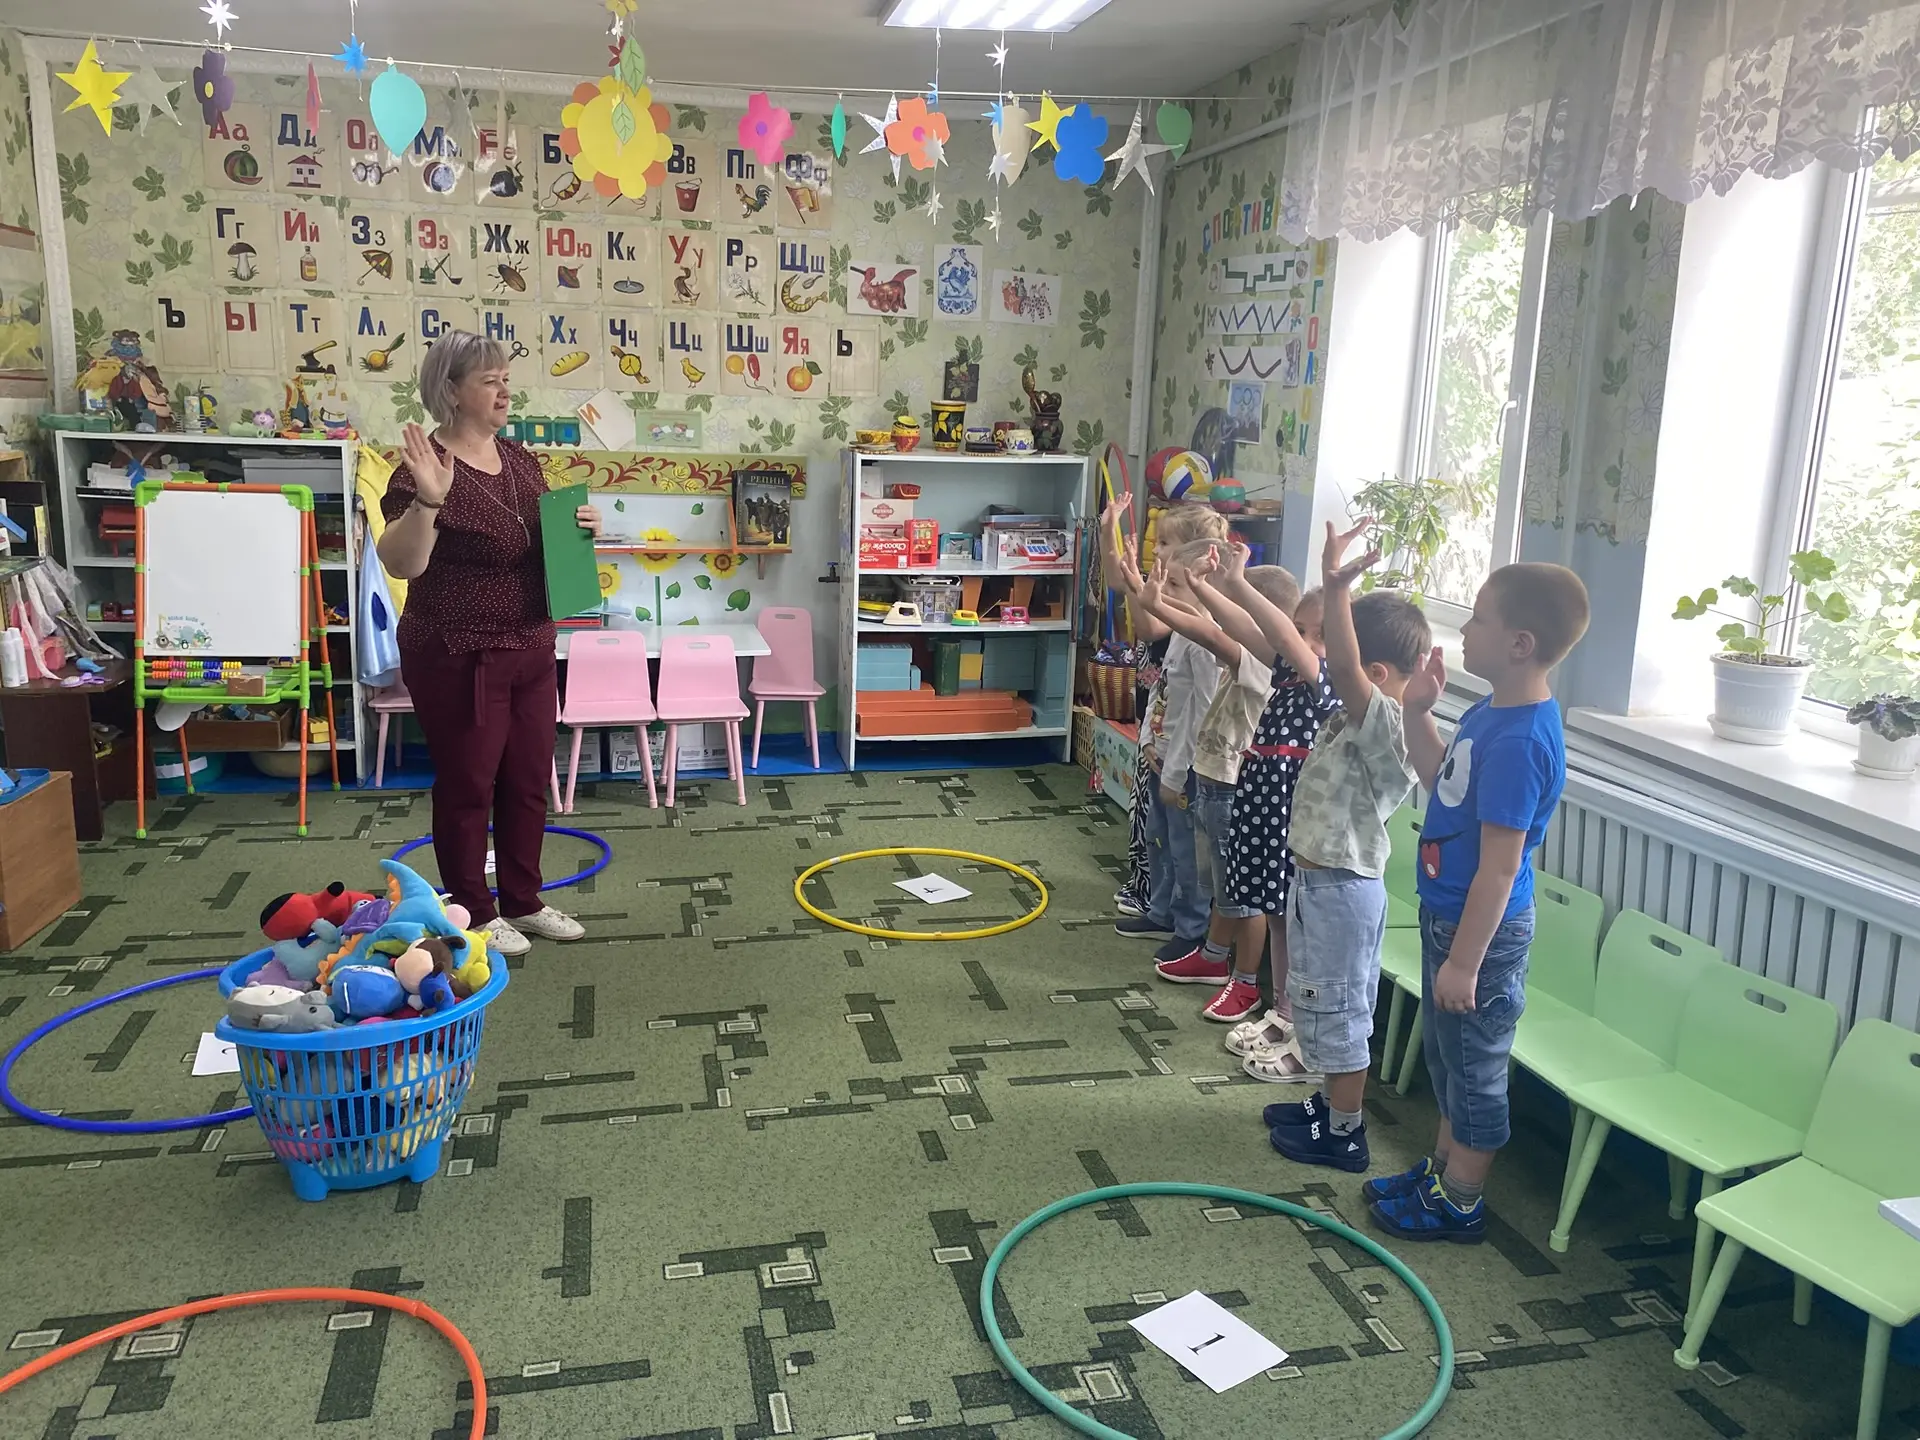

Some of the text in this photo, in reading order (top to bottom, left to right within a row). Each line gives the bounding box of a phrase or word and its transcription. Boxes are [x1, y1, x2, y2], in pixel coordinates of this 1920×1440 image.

[543, 134, 573, 165] Б
[727, 149, 755, 179] Пп
[216, 208, 245, 239] Гг
[284, 207, 320, 242] Йй
[352, 215, 386, 246] Зз
[483, 223, 530, 255] Жж
[546, 227, 592, 258] Юю
[607, 231, 636, 261] Кк
[668, 235, 704, 269] Уу
[726, 238, 758, 272] Рр
[158, 298, 186, 328] Ъ
[224, 301, 257, 332] Ы
[289, 303, 321, 333] Тт
[358, 306, 387, 336] Лл
[485, 312, 515, 341] Нн
[549, 315, 577, 345] Хх
[609, 319, 638, 348] Чч
[669, 321, 703, 352] Цц
[726, 324, 769, 353] Шш
[782, 326, 810, 355] Яя
[750, 475, 785, 485] РЕПИН
[1184, 1331, 1226, 1356] 1
